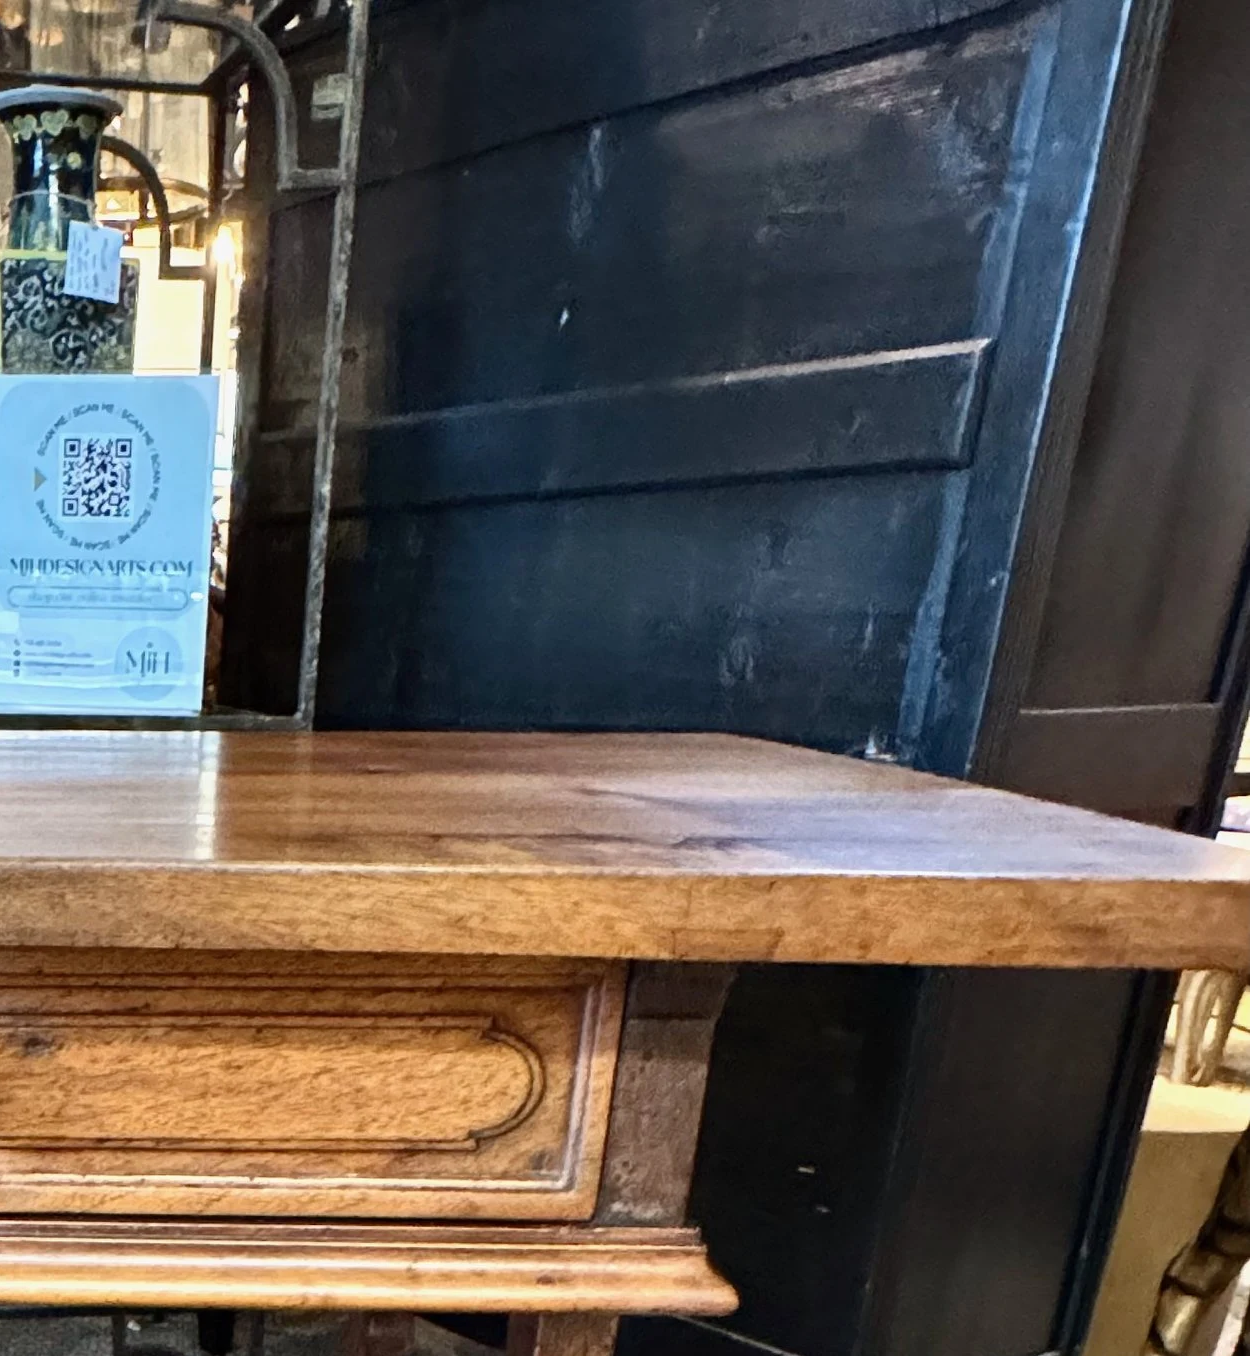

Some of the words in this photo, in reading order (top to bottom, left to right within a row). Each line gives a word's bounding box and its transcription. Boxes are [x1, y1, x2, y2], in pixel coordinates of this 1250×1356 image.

[73, 404, 99, 417] SCAN
[121, 409, 144, 432] SCAN
[37, 429, 56, 457] SCAN
[150, 453, 162, 485] SCAN
[131, 508, 151, 533] SCAN
